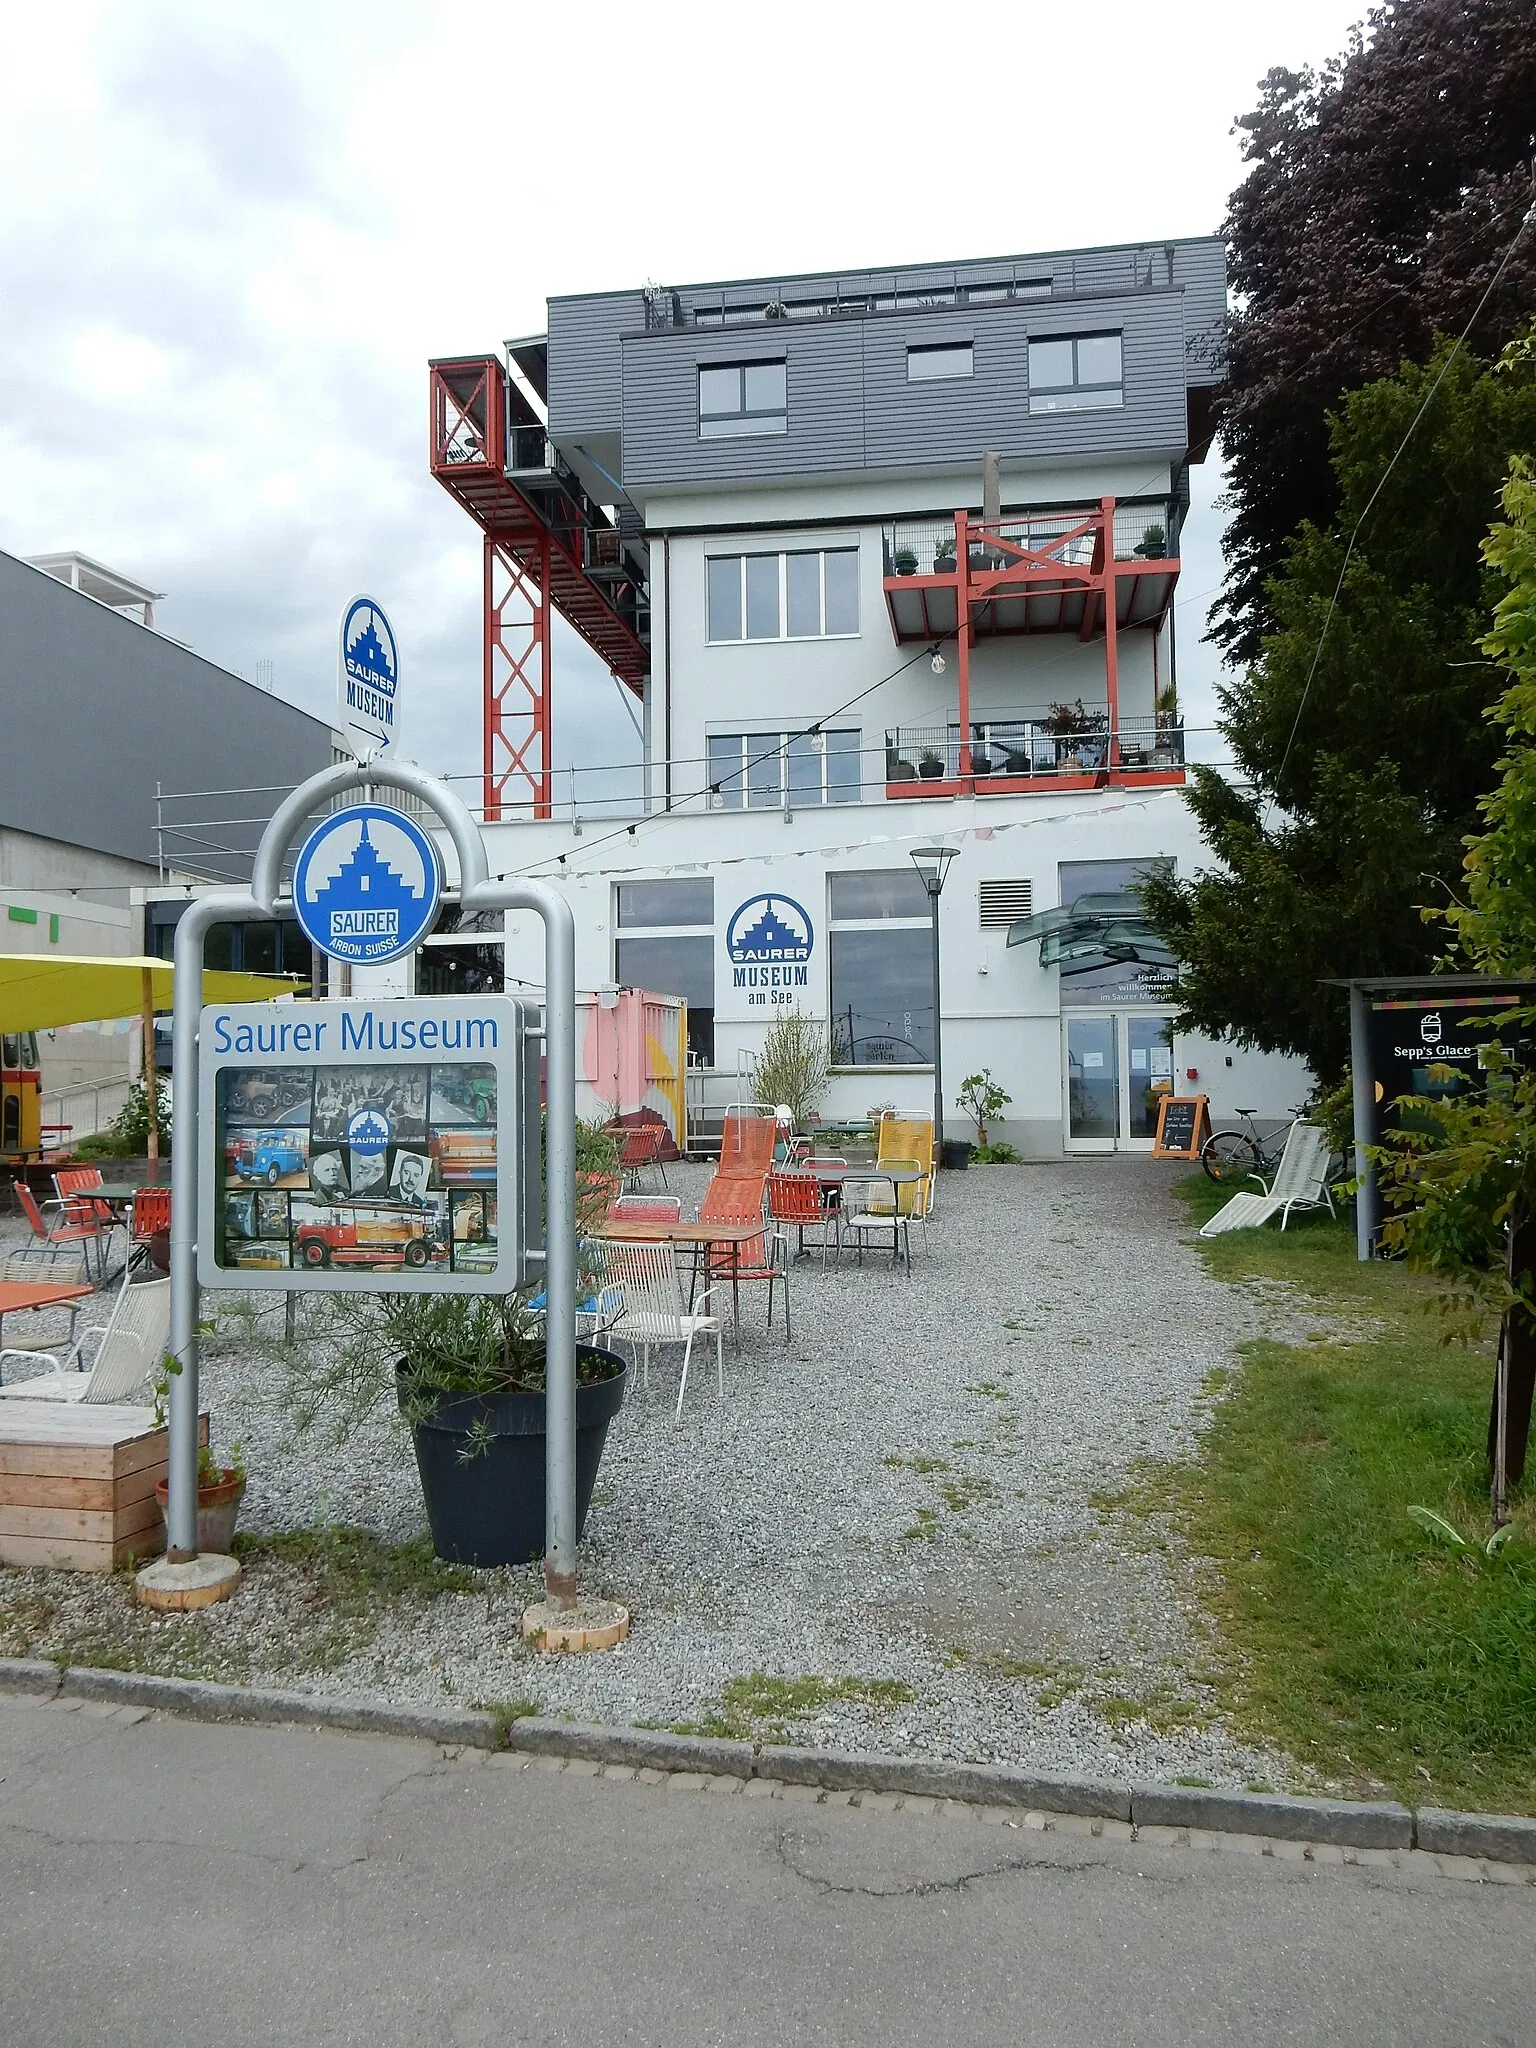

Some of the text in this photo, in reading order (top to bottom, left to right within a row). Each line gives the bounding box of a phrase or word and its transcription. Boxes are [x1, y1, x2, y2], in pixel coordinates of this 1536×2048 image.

[346, 658, 394, 694] SAURER
[346, 680, 394, 726] MUSEUM
[333, 912, 397, 933] SAURER
[329, 935, 399, 955] ARBON SUISSE
[732, 948, 808, 960] SAURER
[733, 966, 808, 987] MUSEUM
[1138, 972, 1173, 981] Herzlich
[748, 990, 792, 1005] am See
[1100, 993, 1111, 1001] im
[1112, 993, 1137, 1001] Saurer
[214, 1012, 498, 1053] Saurer Museum
[904, 1012, 912, 1040] open
[1394, 1045, 1471, 1060] Sepp's Glace
